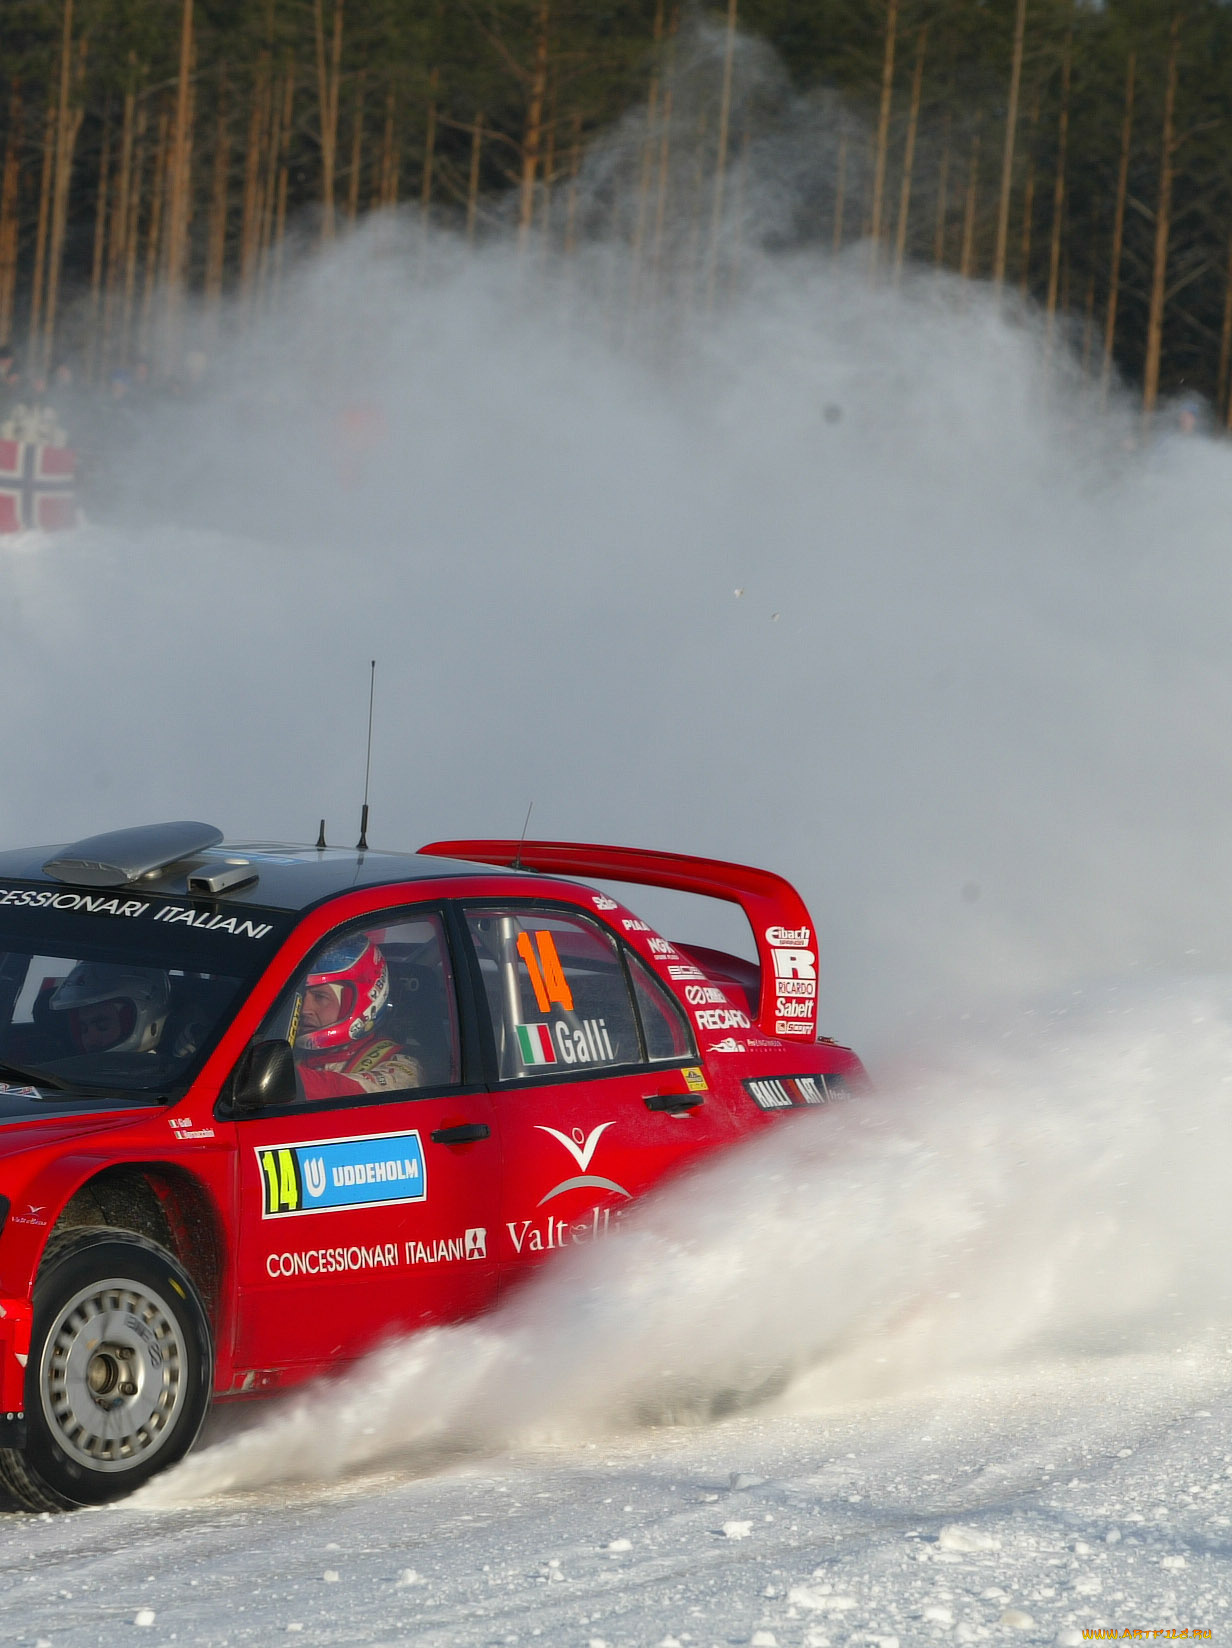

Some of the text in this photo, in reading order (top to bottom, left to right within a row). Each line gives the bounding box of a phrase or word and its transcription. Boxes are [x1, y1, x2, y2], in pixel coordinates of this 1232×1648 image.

[154, 905, 274, 940] ITALIANI
[765, 926, 810, 947] Eibach
[516, 930, 574, 1013] 14
[694, 1009, 750, 1030] RECARO
[775, 997, 814, 1018] Sabelt
[555, 1018, 614, 1064] Galli
[262, 1149, 298, 1212] 14
[332, 1158, 418, 1187] UDDEHOLM
[506, 1206, 627, 1253] Valtelli
[266, 1237, 464, 1277] CONCESSIONARI ITALIANI
